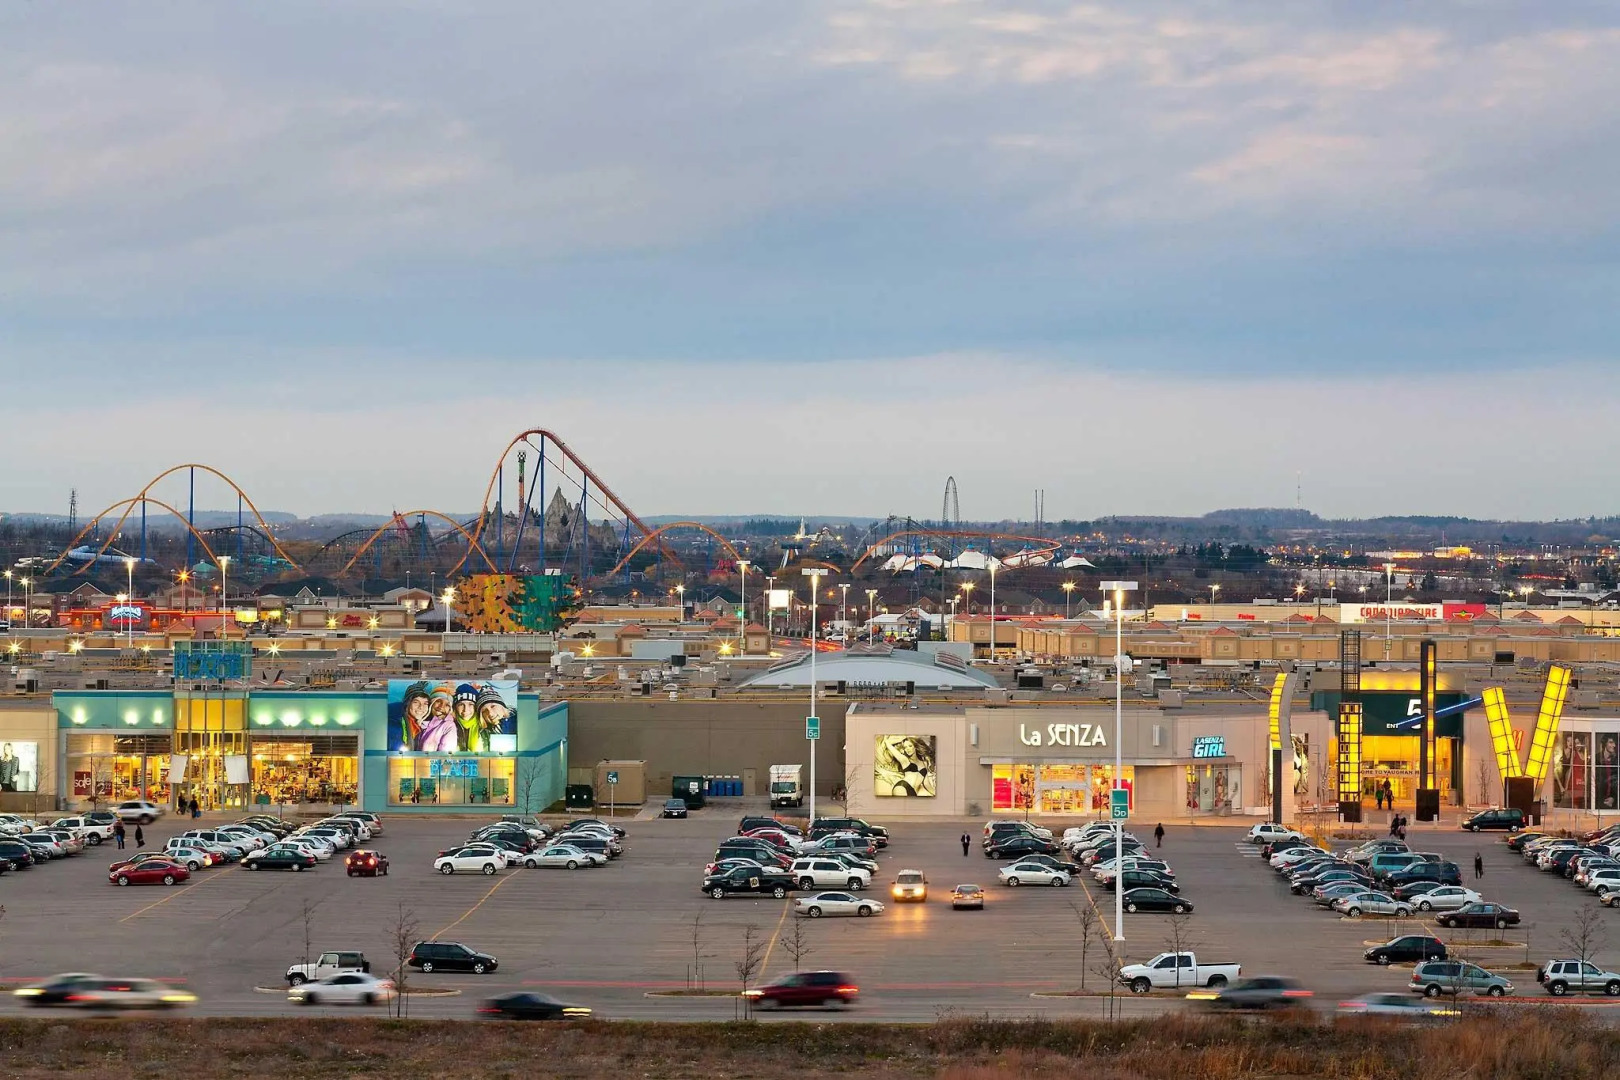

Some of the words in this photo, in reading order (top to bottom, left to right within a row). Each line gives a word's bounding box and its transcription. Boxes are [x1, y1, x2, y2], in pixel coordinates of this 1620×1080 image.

[1020, 723, 1042, 746] La
[1047, 723, 1107, 746] SENZA
[1194, 743, 1226, 758] GIRL
[430, 763, 478, 777] PLACE
[1114, 806, 1127, 817] 5D
